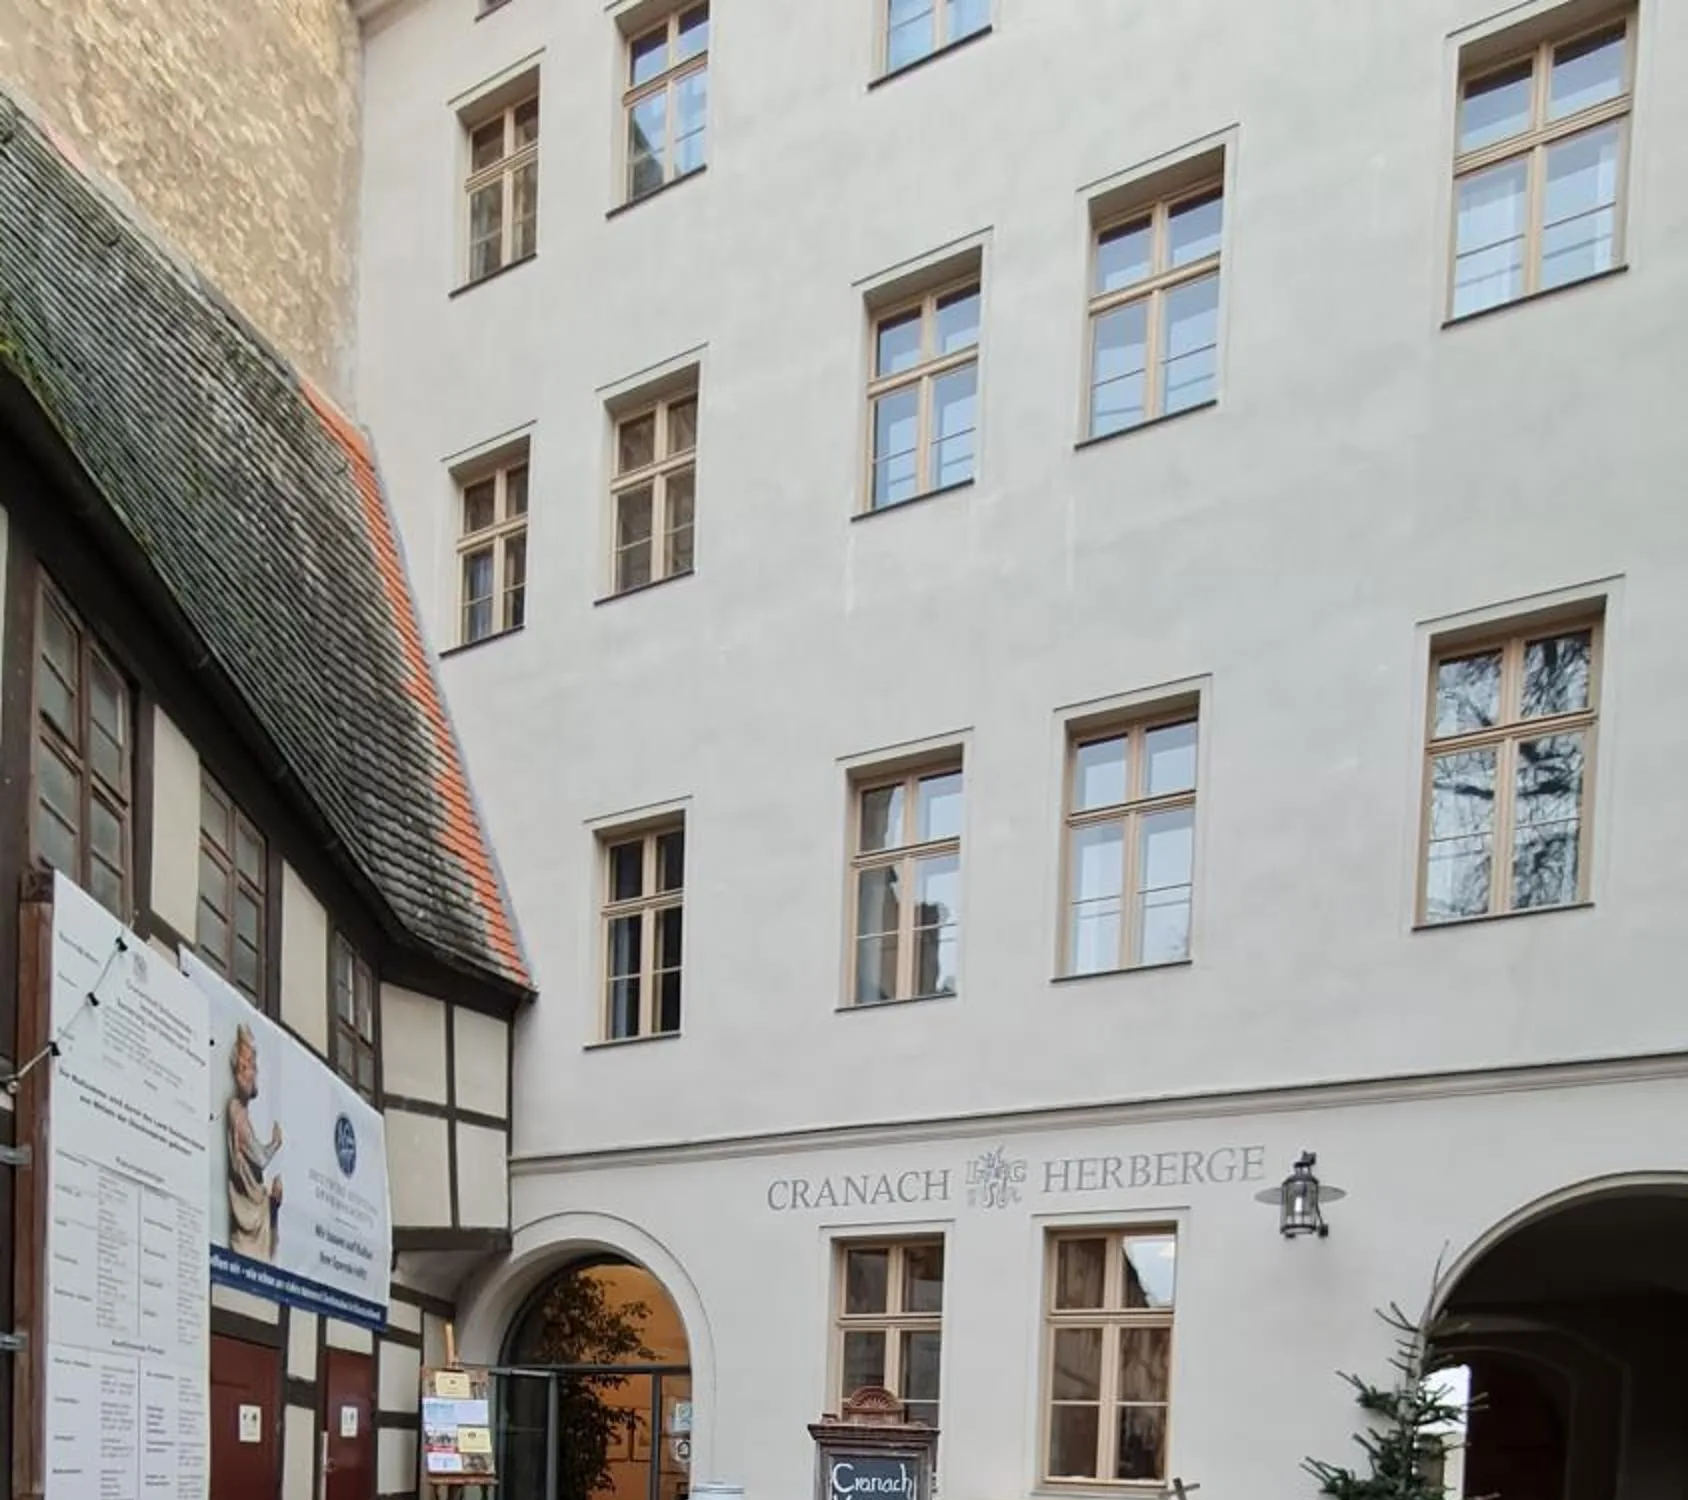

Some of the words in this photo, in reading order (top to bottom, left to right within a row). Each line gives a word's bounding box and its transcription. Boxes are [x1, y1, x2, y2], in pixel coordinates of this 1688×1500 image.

[767, 1168, 952, 1211] CRANACH
[1041, 1146, 1265, 1193] HERBERGE
[831, 1463, 912, 1500] Cranach
